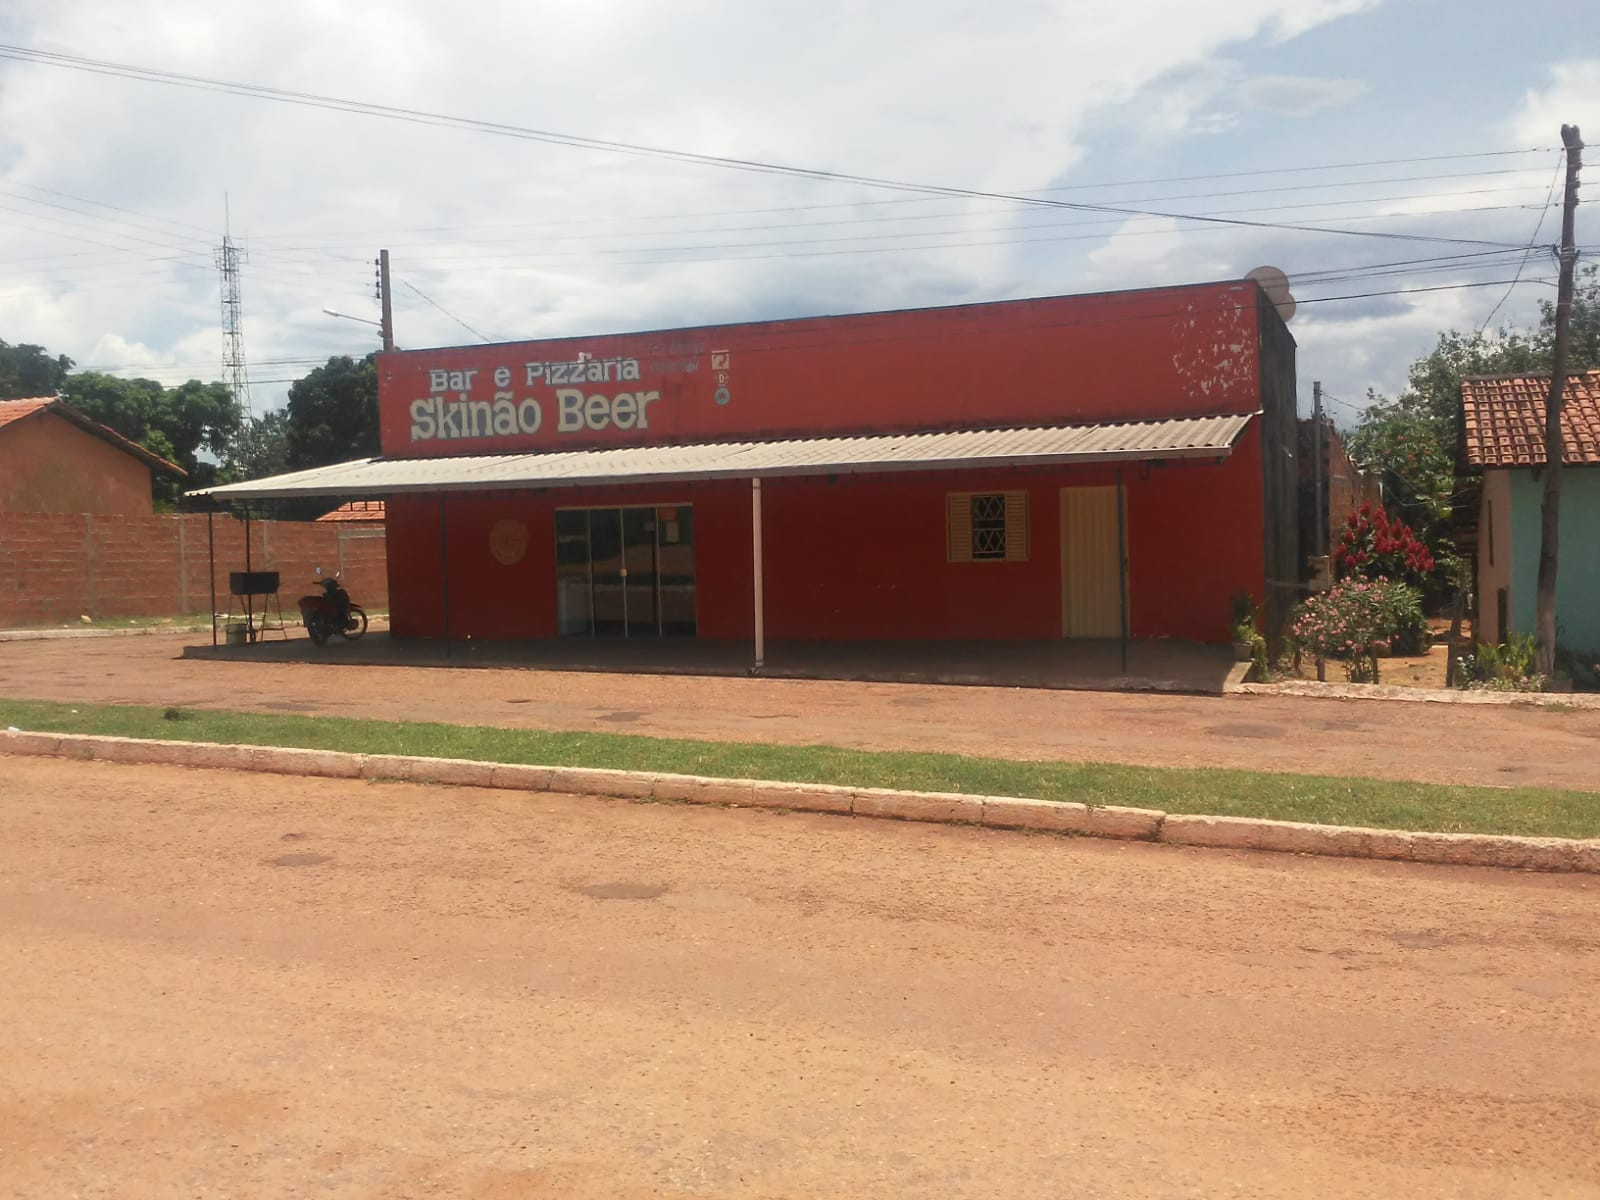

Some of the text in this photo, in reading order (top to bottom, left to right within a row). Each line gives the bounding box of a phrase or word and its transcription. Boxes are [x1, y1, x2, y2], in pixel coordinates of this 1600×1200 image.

[429, 368, 478, 392] Bar
[494, 366, 511, 388] e
[524, 357, 641, 386] Pizzaria
[409, 388, 660, 443] Skinão Beer
